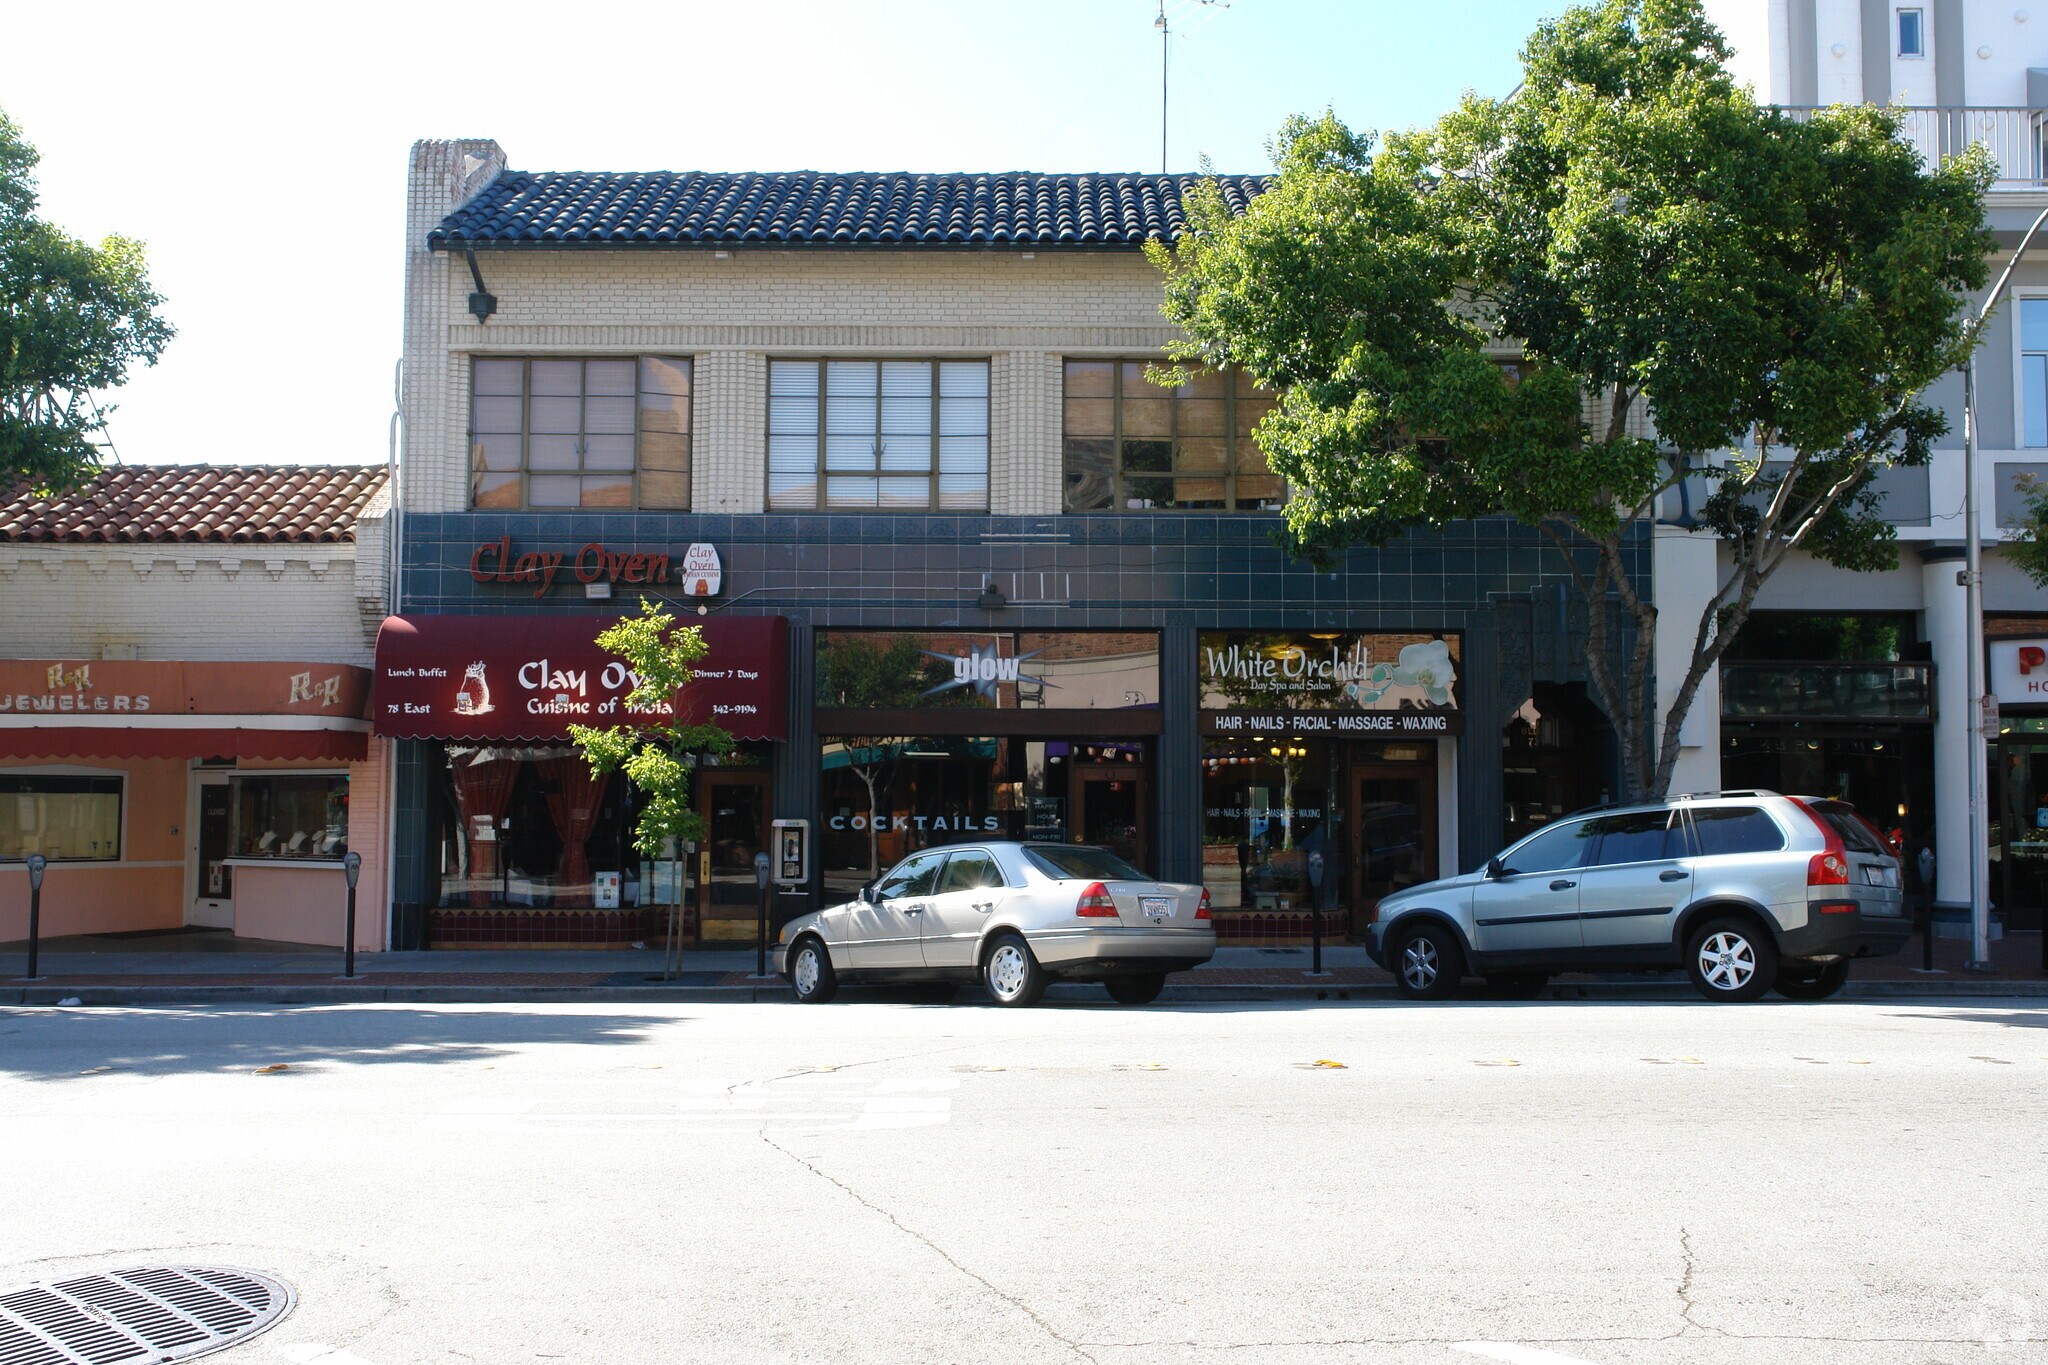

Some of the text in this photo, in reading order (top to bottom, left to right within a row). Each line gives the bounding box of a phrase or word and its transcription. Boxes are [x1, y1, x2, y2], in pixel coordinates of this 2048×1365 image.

[690, 546, 713, 561] Clay
[470, 535, 669, 598] Clay Oven
[690, 561, 713, 570] Oven
[954, 653, 1019, 684] glow
[1207, 644, 1367, 681] White Orchid
[388, 668, 447, 677] Lunch Buffet
[518, 659, 683, 697] Clay Ov
[694, 669, 759, 680] Dinner 7 Days
[1250, 679, 1331, 694] Day Spa and Salon
[387, 702, 430, 713] 78 East
[527, 698, 590, 714] Cuisine
[598, 696, 618, 714] of
[713, 705, 757, 714] 342-9194
[1215, 716, 1242, 730] HAIR
[1251, 716, 1284, 730] NAILS
[1293, 716, 1331, 730] FACIAL
[1338, 716, 1393, 730] MASSAGE
[1402, 716, 1446, 730] WAXING
[1207, 808, 1220, 816] HAIR
[1223, 808, 1241, 817] NAILS
[1298, 809, 1320, 817] WAXING
[829, 815, 999, 831] COCKTAILS
